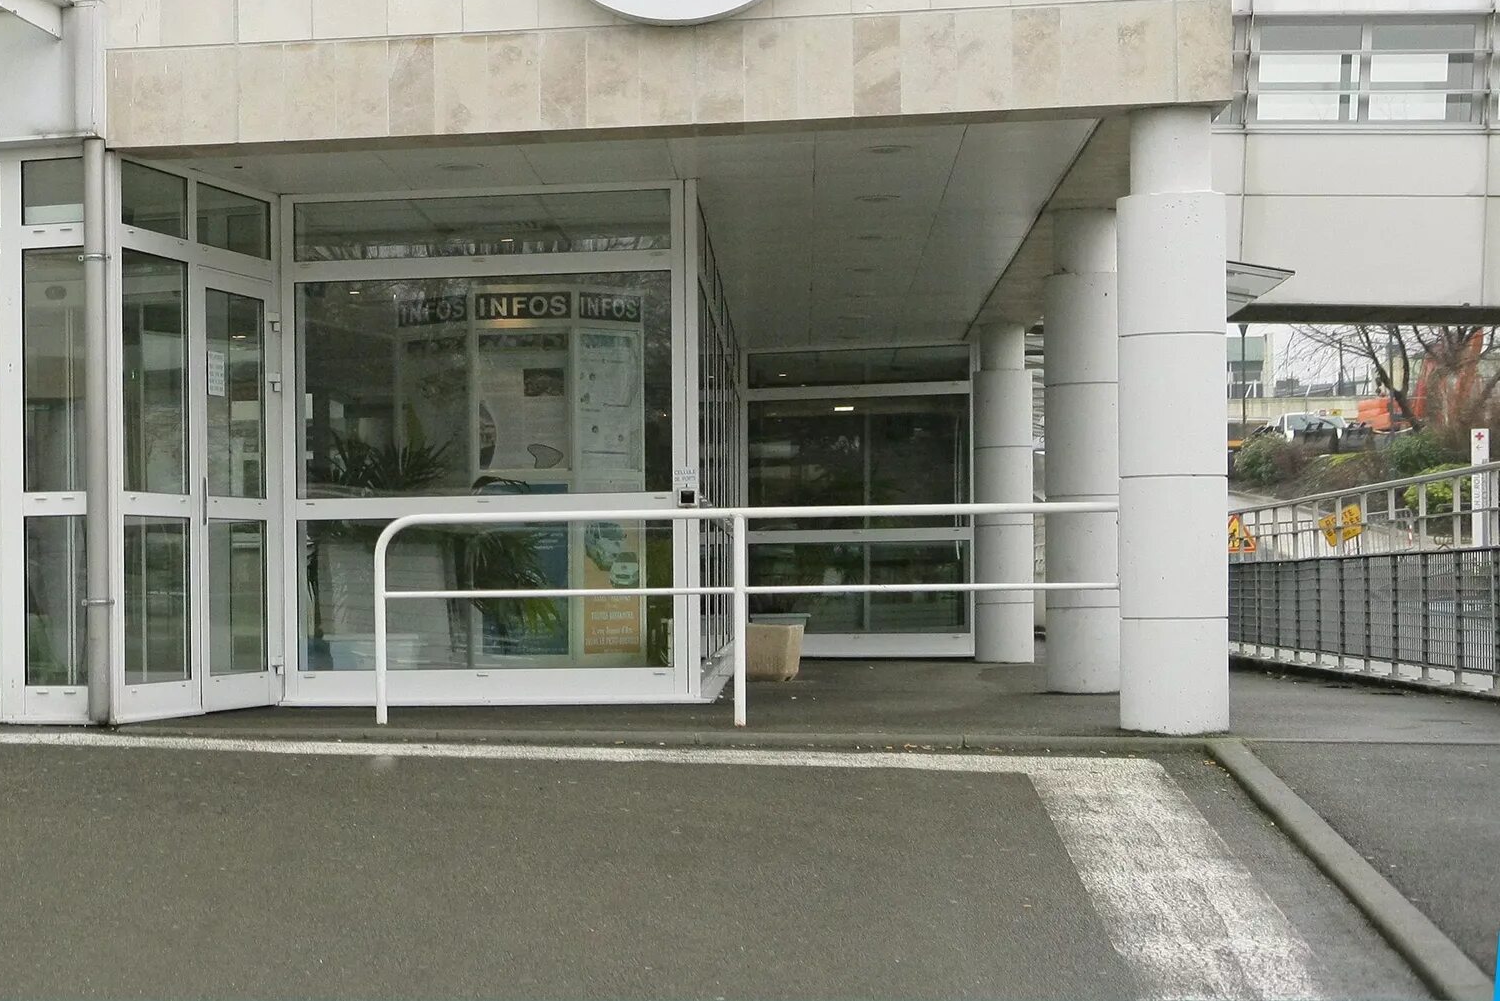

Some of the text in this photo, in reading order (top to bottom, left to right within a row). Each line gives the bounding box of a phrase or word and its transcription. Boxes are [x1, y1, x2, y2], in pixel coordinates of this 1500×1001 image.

[401, 300, 466, 323] INFOS
[479, 296, 567, 317] INFOS
[581, 297, 638, 319] INFOS
